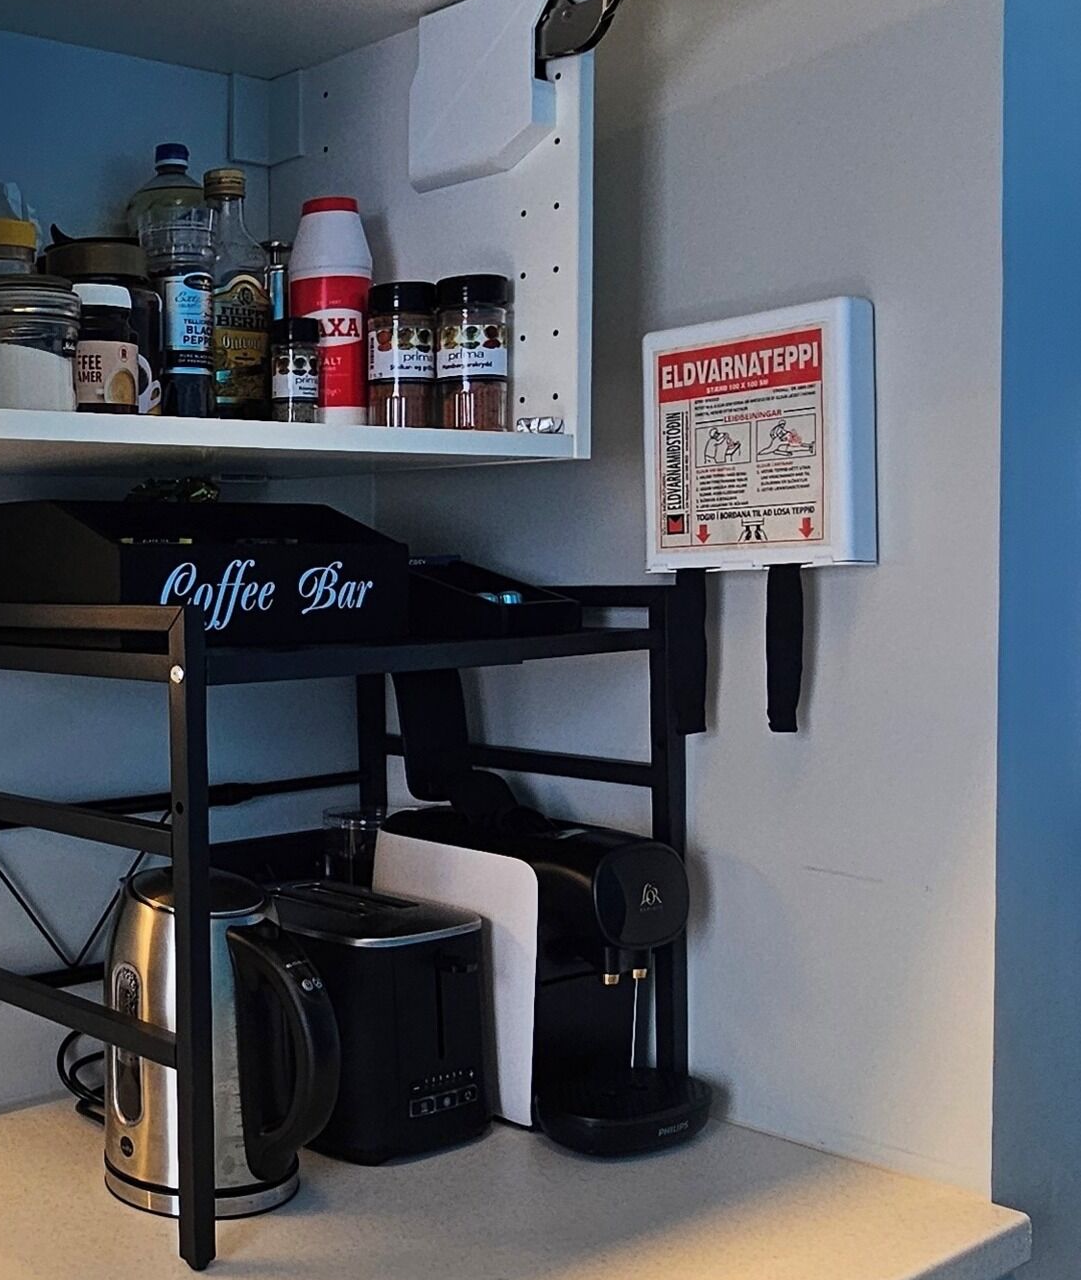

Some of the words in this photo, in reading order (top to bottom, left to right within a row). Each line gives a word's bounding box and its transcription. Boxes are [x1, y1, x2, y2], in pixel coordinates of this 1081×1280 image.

[186, 325, 212, 335] BLAC
[320, 318, 360, 337] AXA
[323, 357, 342, 366] ALT
[662, 341, 819, 390] ELDVARNATEPPI
[729, 382, 740, 391] 100
[747, 380, 758, 388] 100
[663, 412, 681, 510] ELDVARNAMIÐSTÖÐIN
[752, 509, 761, 517] TIL
[773, 507, 791, 516] LOSA
[160, 559, 275, 631] Coffee
[299, 561, 373, 614] Bar
